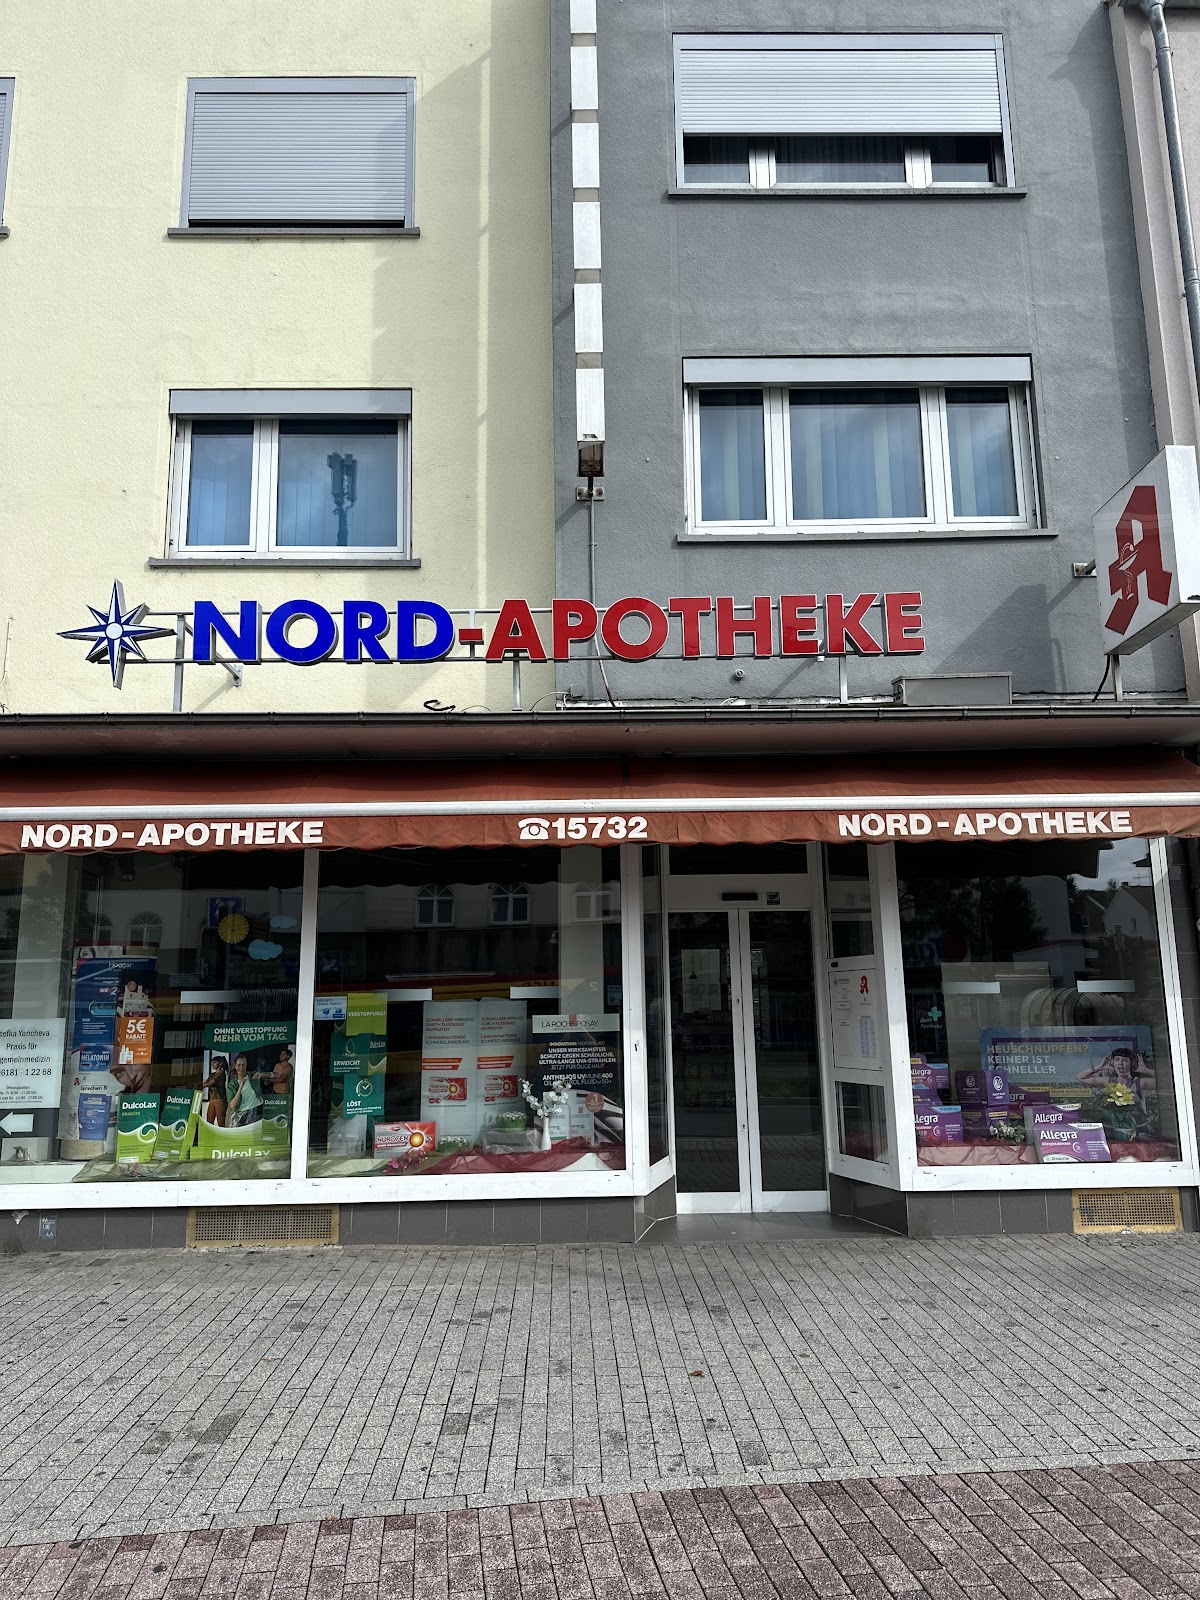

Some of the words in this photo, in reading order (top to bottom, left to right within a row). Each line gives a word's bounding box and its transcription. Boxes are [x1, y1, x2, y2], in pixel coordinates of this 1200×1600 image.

[193, 591, 926, 666] NORD-APOTHEKE
[551, 815, 648, 841] 15732
[126, 1019, 147, 1034] 5€
[236, 1026, 288, 1034] VERSTOPFUNG
[19, 1029, 50, 1037] Yancheva
[213, 1035, 241, 1043] MEHR
[242, 1034, 264, 1042] VOM
[266, 1033, 288, 1042] TAG.
[6, 1042, 27, 1050] Praxis
[28, 1042, 38, 1050] für
[986, 1044, 1089, 1054] HEUSCHNUPFEN?
[81, 1053, 110, 1061] MELATONIN
[987, 1055, 1030, 1064] KEINER
[1032, 1054, 1050, 1063] IST
[1034, 1113, 1063, 1124] Allegra
[377, 1135, 409, 1143] NUROFEN
[1040, 1130, 1078, 1142] Allegra
